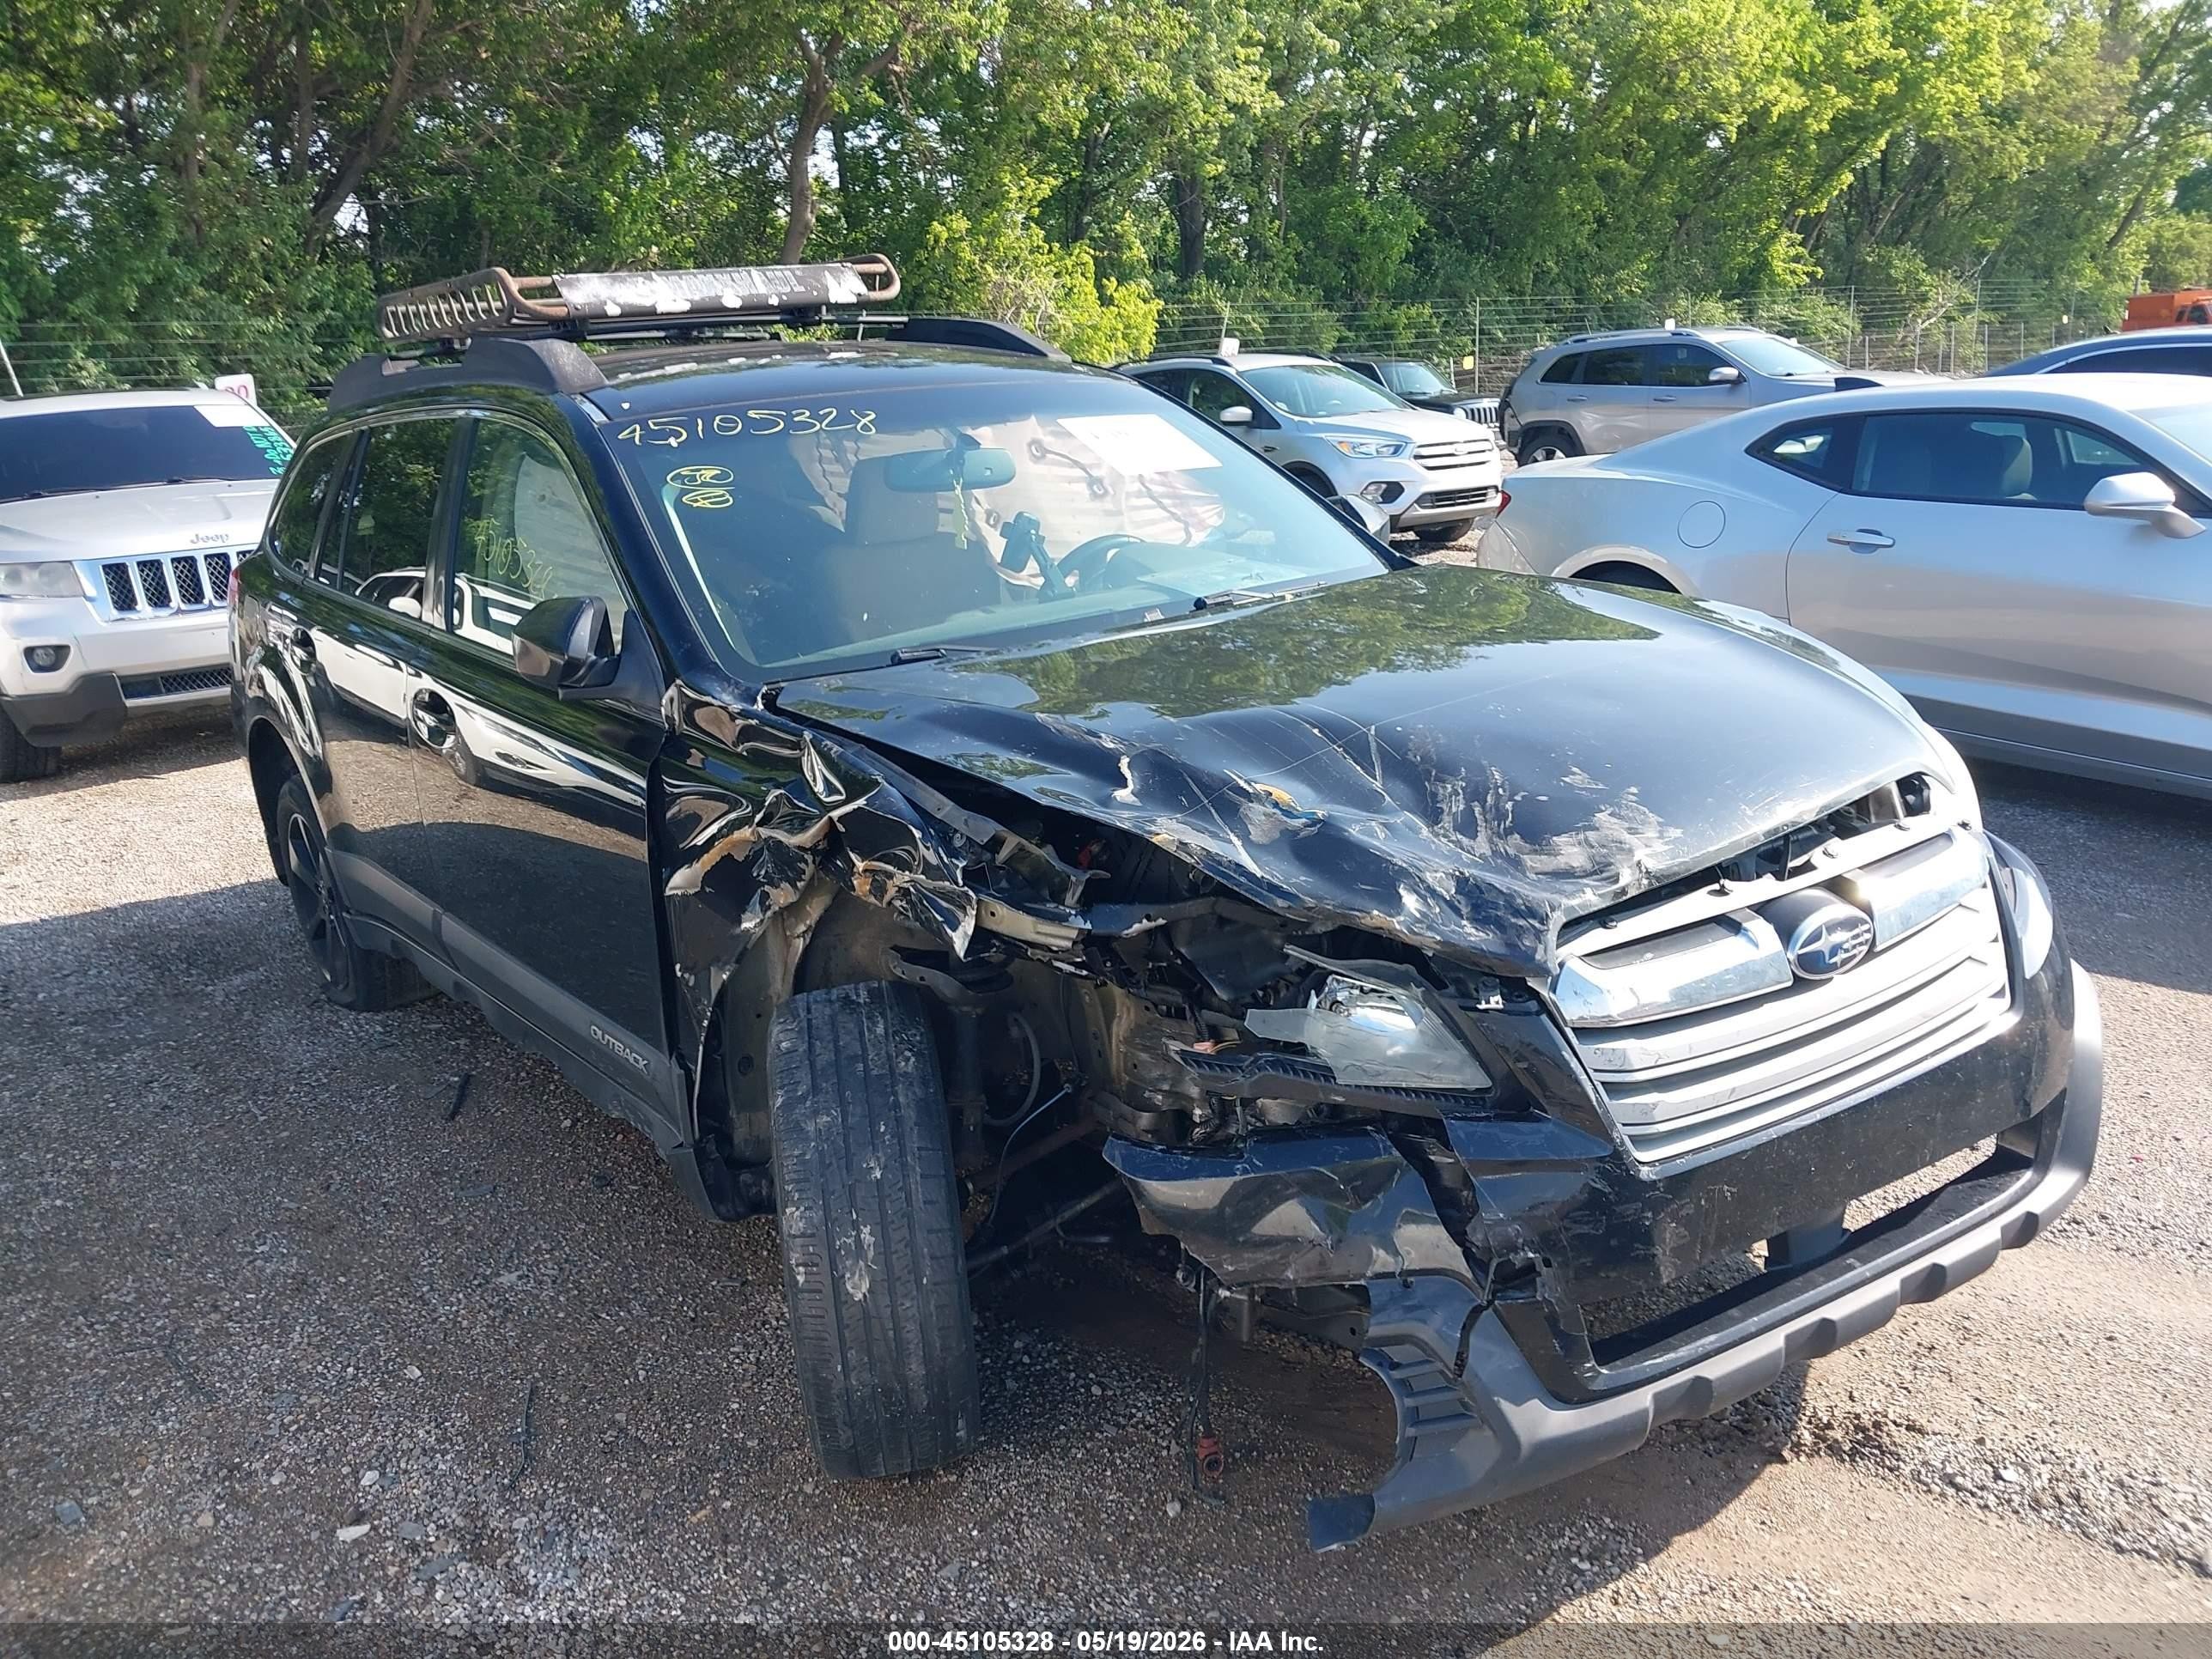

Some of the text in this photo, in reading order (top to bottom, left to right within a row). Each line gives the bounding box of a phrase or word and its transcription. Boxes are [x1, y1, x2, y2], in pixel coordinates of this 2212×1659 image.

[617, 408, 877, 447] 45105328
[190, 533, 230, 544] Jeep
[590, 1024, 649, 1075] OUTBACK
